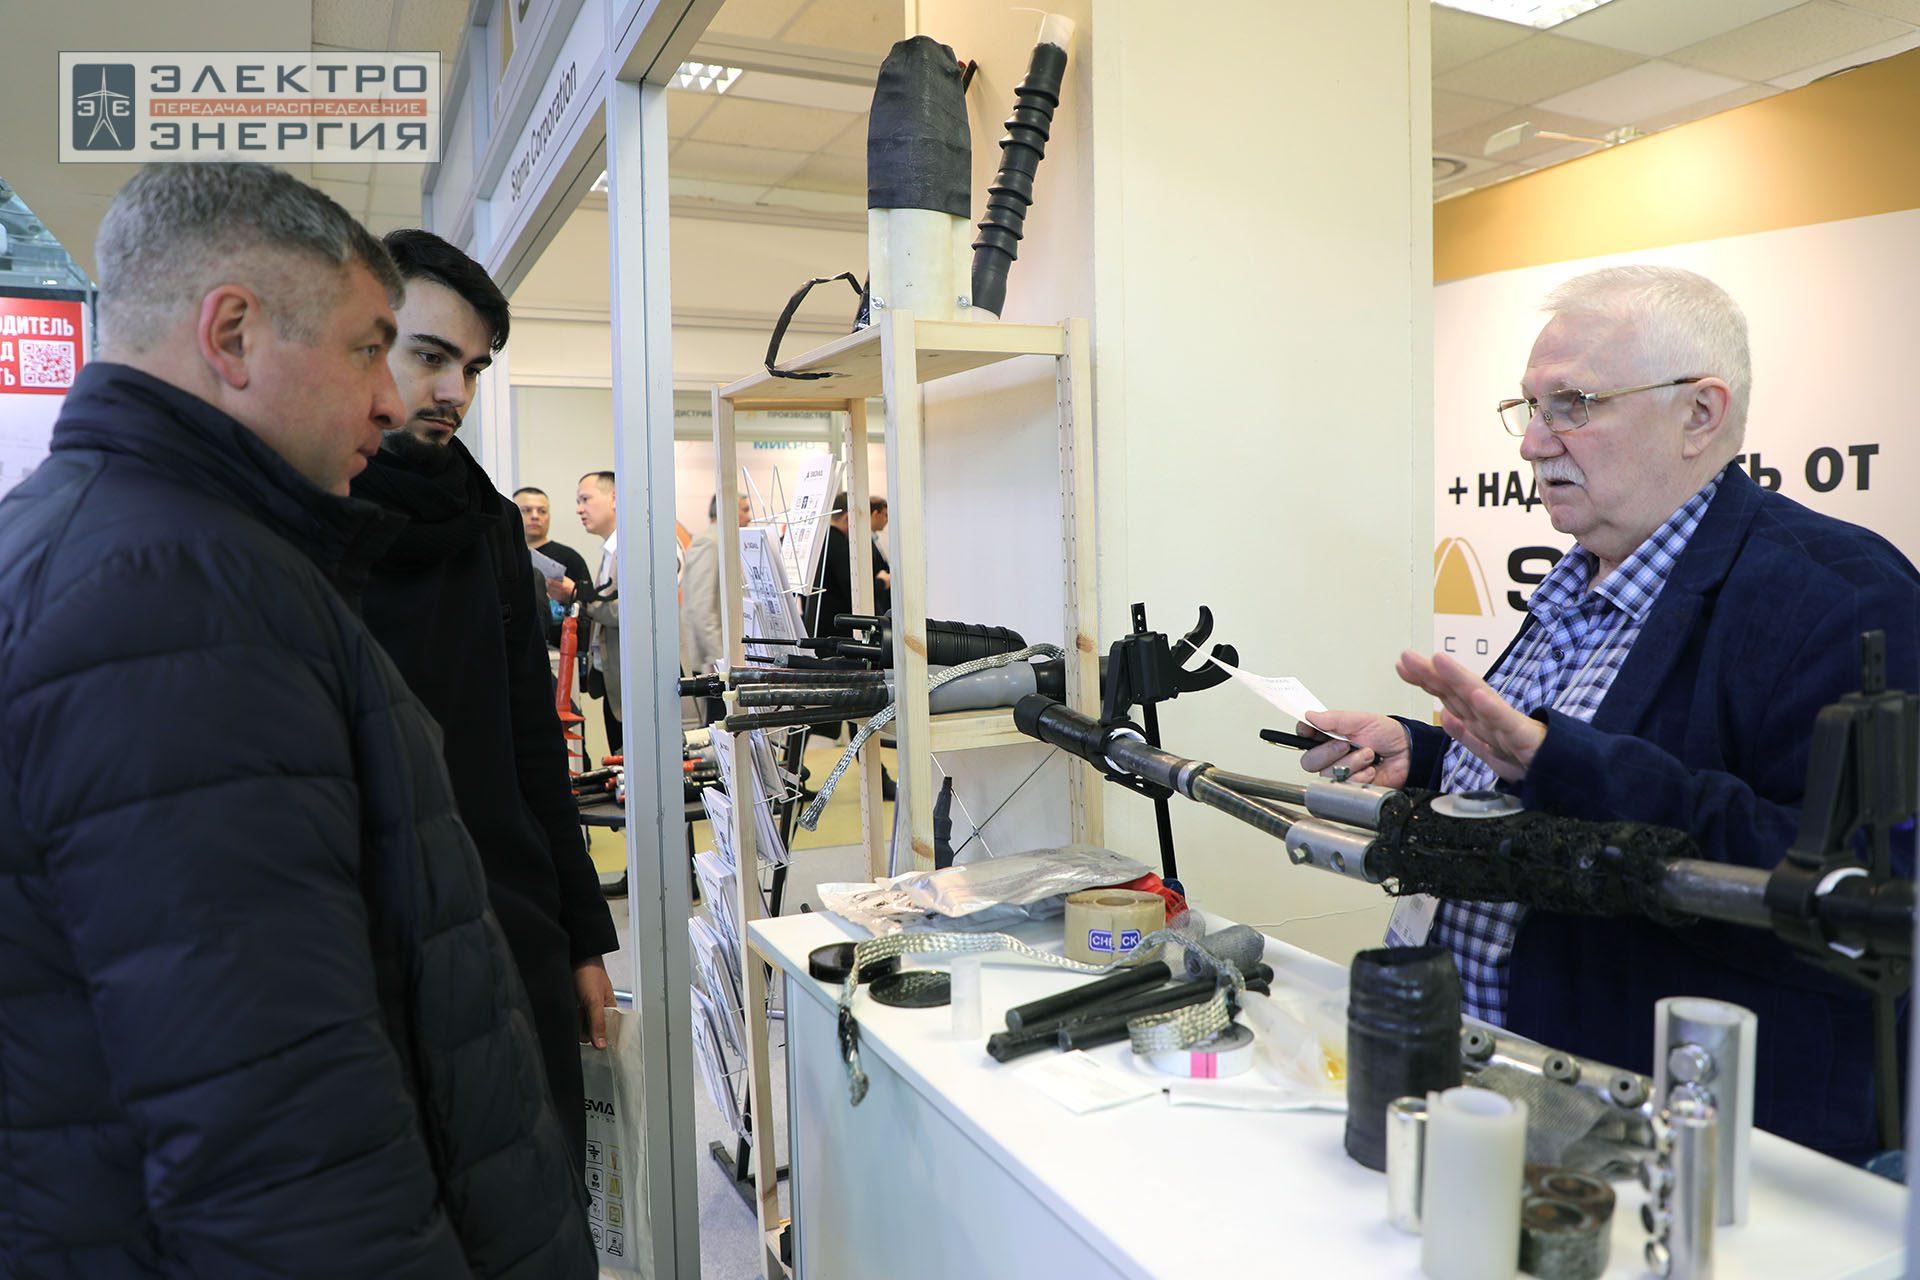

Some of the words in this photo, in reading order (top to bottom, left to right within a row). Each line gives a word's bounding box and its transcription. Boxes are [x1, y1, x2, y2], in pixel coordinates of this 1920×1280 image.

[511, 151, 529, 202] Sigma
[531, 61, 576, 166] Corporation
[0, 315, 74, 336] ДИТЕЛЬ
[1805, 444, 1879, 493] ОТ
